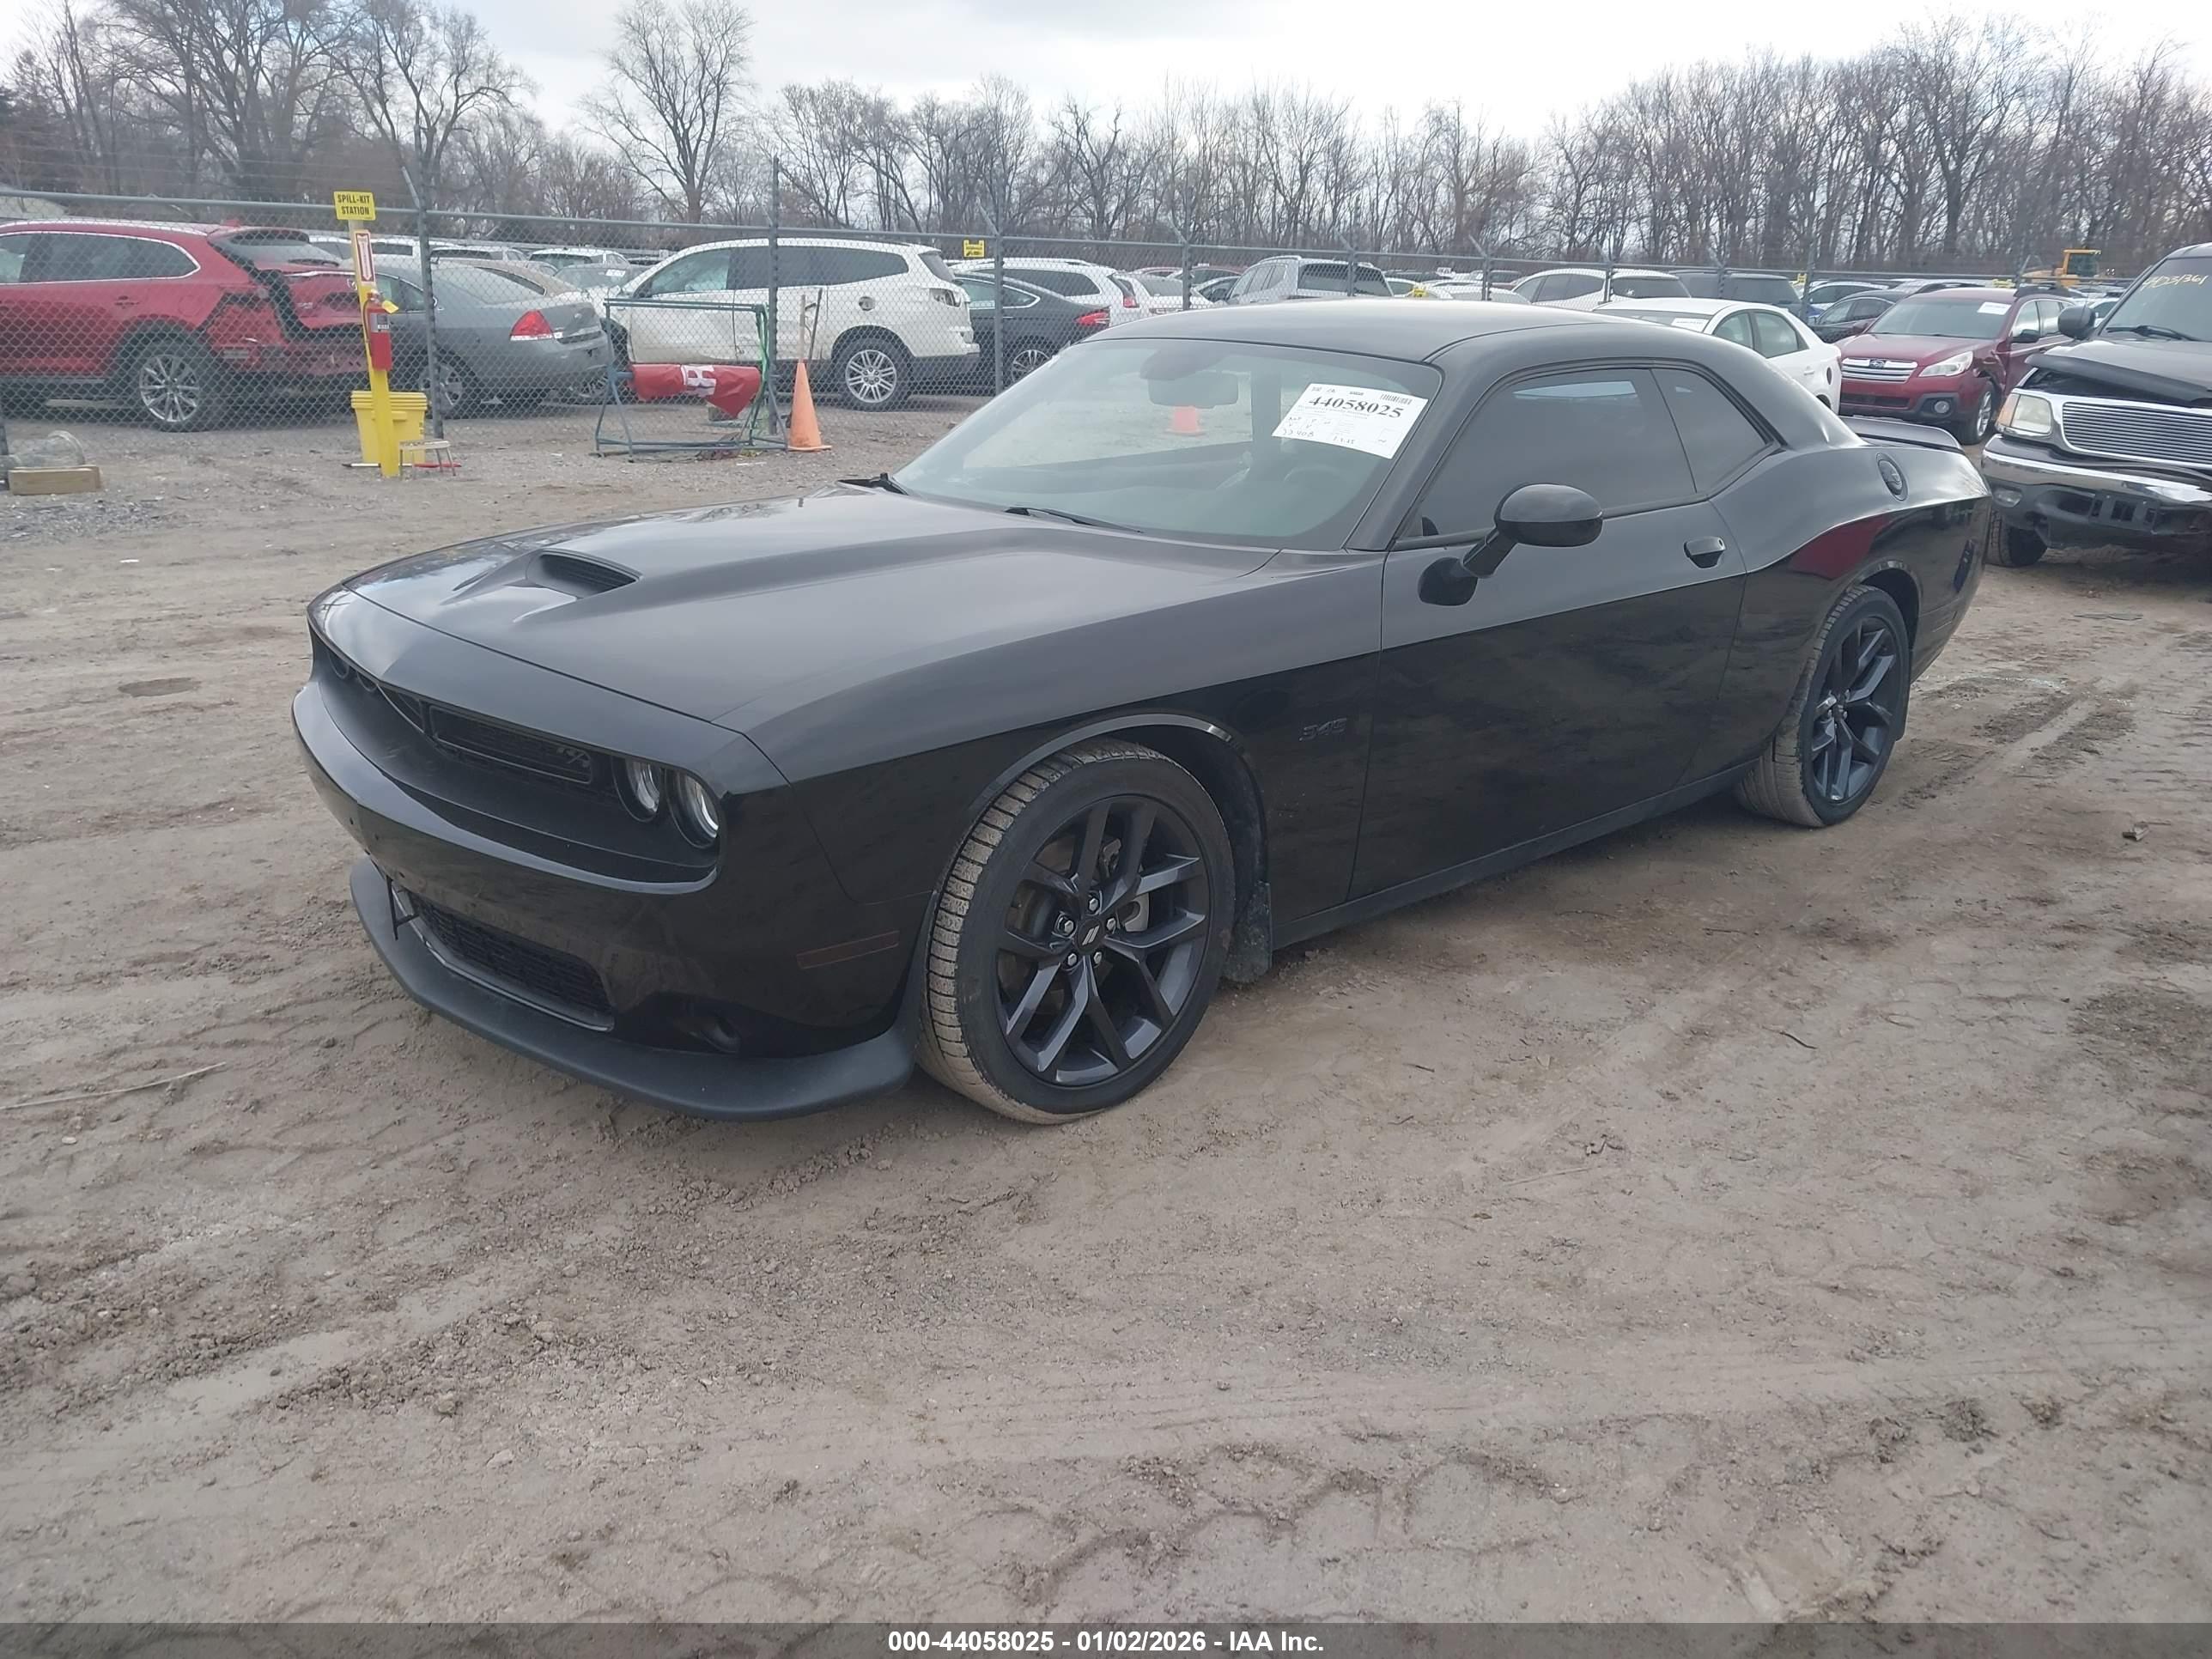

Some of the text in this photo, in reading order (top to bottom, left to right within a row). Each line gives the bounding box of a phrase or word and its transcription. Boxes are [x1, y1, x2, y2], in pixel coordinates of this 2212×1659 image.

[337, 194, 370, 204] SPILL-KIT
[342, 205, 370, 215] STATION
[1309, 396, 1404, 418] 44058025
